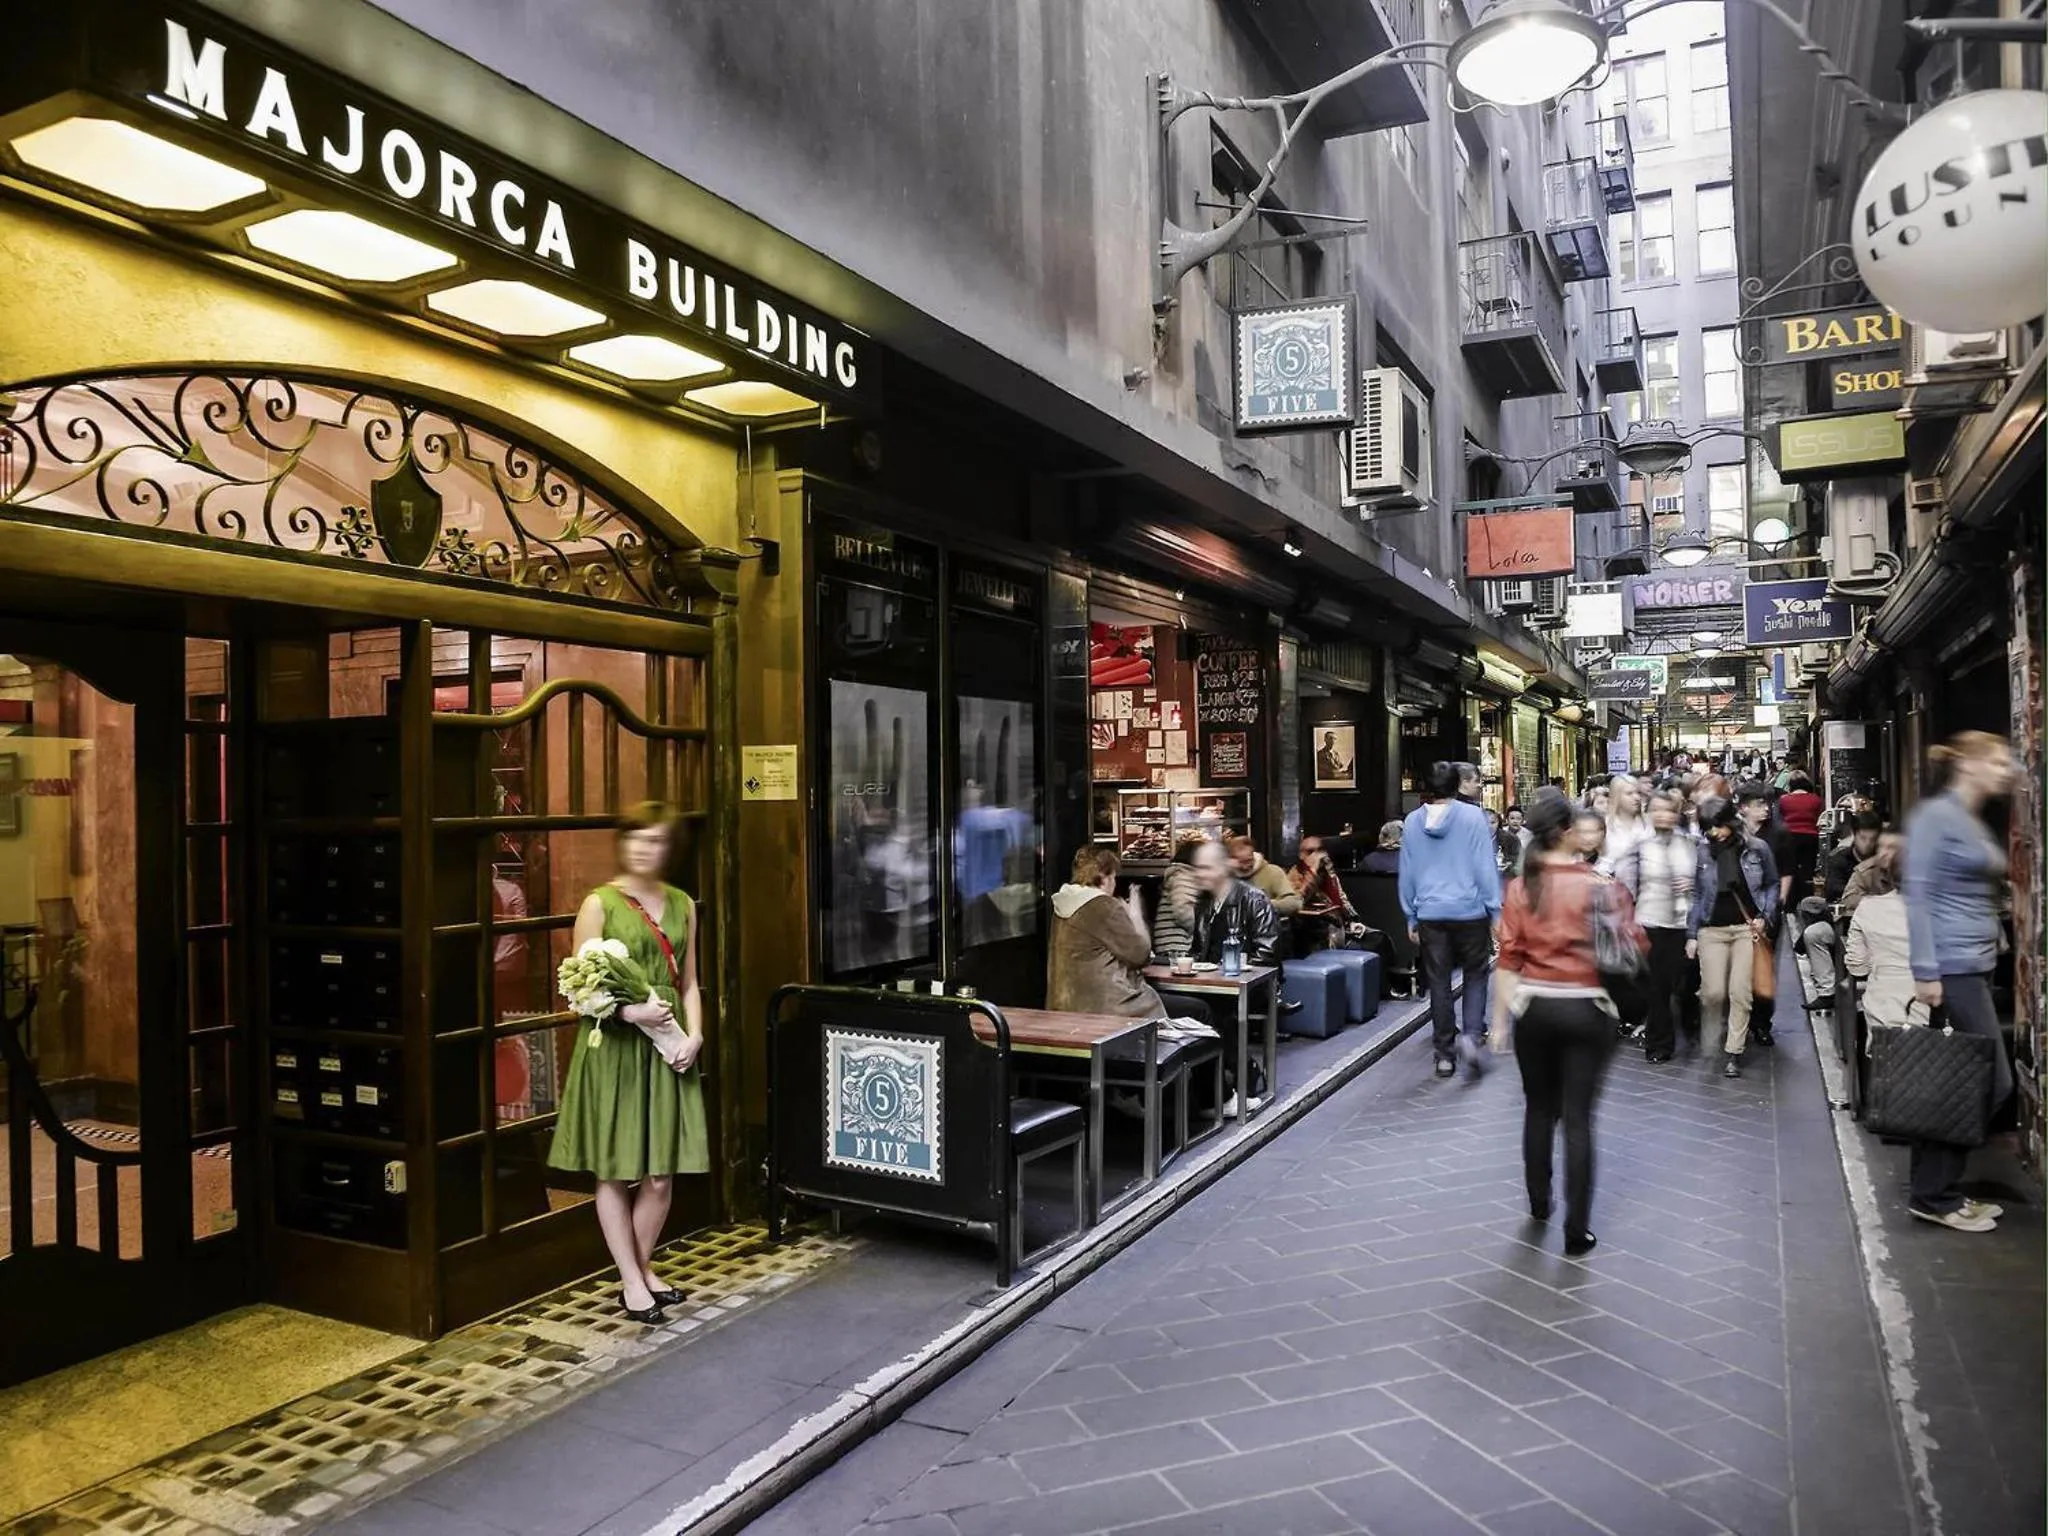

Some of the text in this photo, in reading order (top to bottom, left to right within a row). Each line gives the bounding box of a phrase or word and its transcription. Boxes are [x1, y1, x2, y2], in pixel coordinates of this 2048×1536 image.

[164, 19, 857, 389] MAJORCA BUILDING
[1284, 346, 1301, 371] 5
[1267, 392, 1318, 414] FIVE
[833, 533, 923, 581] BELLEVUE
[955, 567, 1034, 608] JEWELLERY
[1764, 614, 1793, 632] Sushi
[1198, 650, 1259, 672] COFFEE
[874, 1080, 891, 1112] 5
[855, 1135, 910, 1166] FIVE
